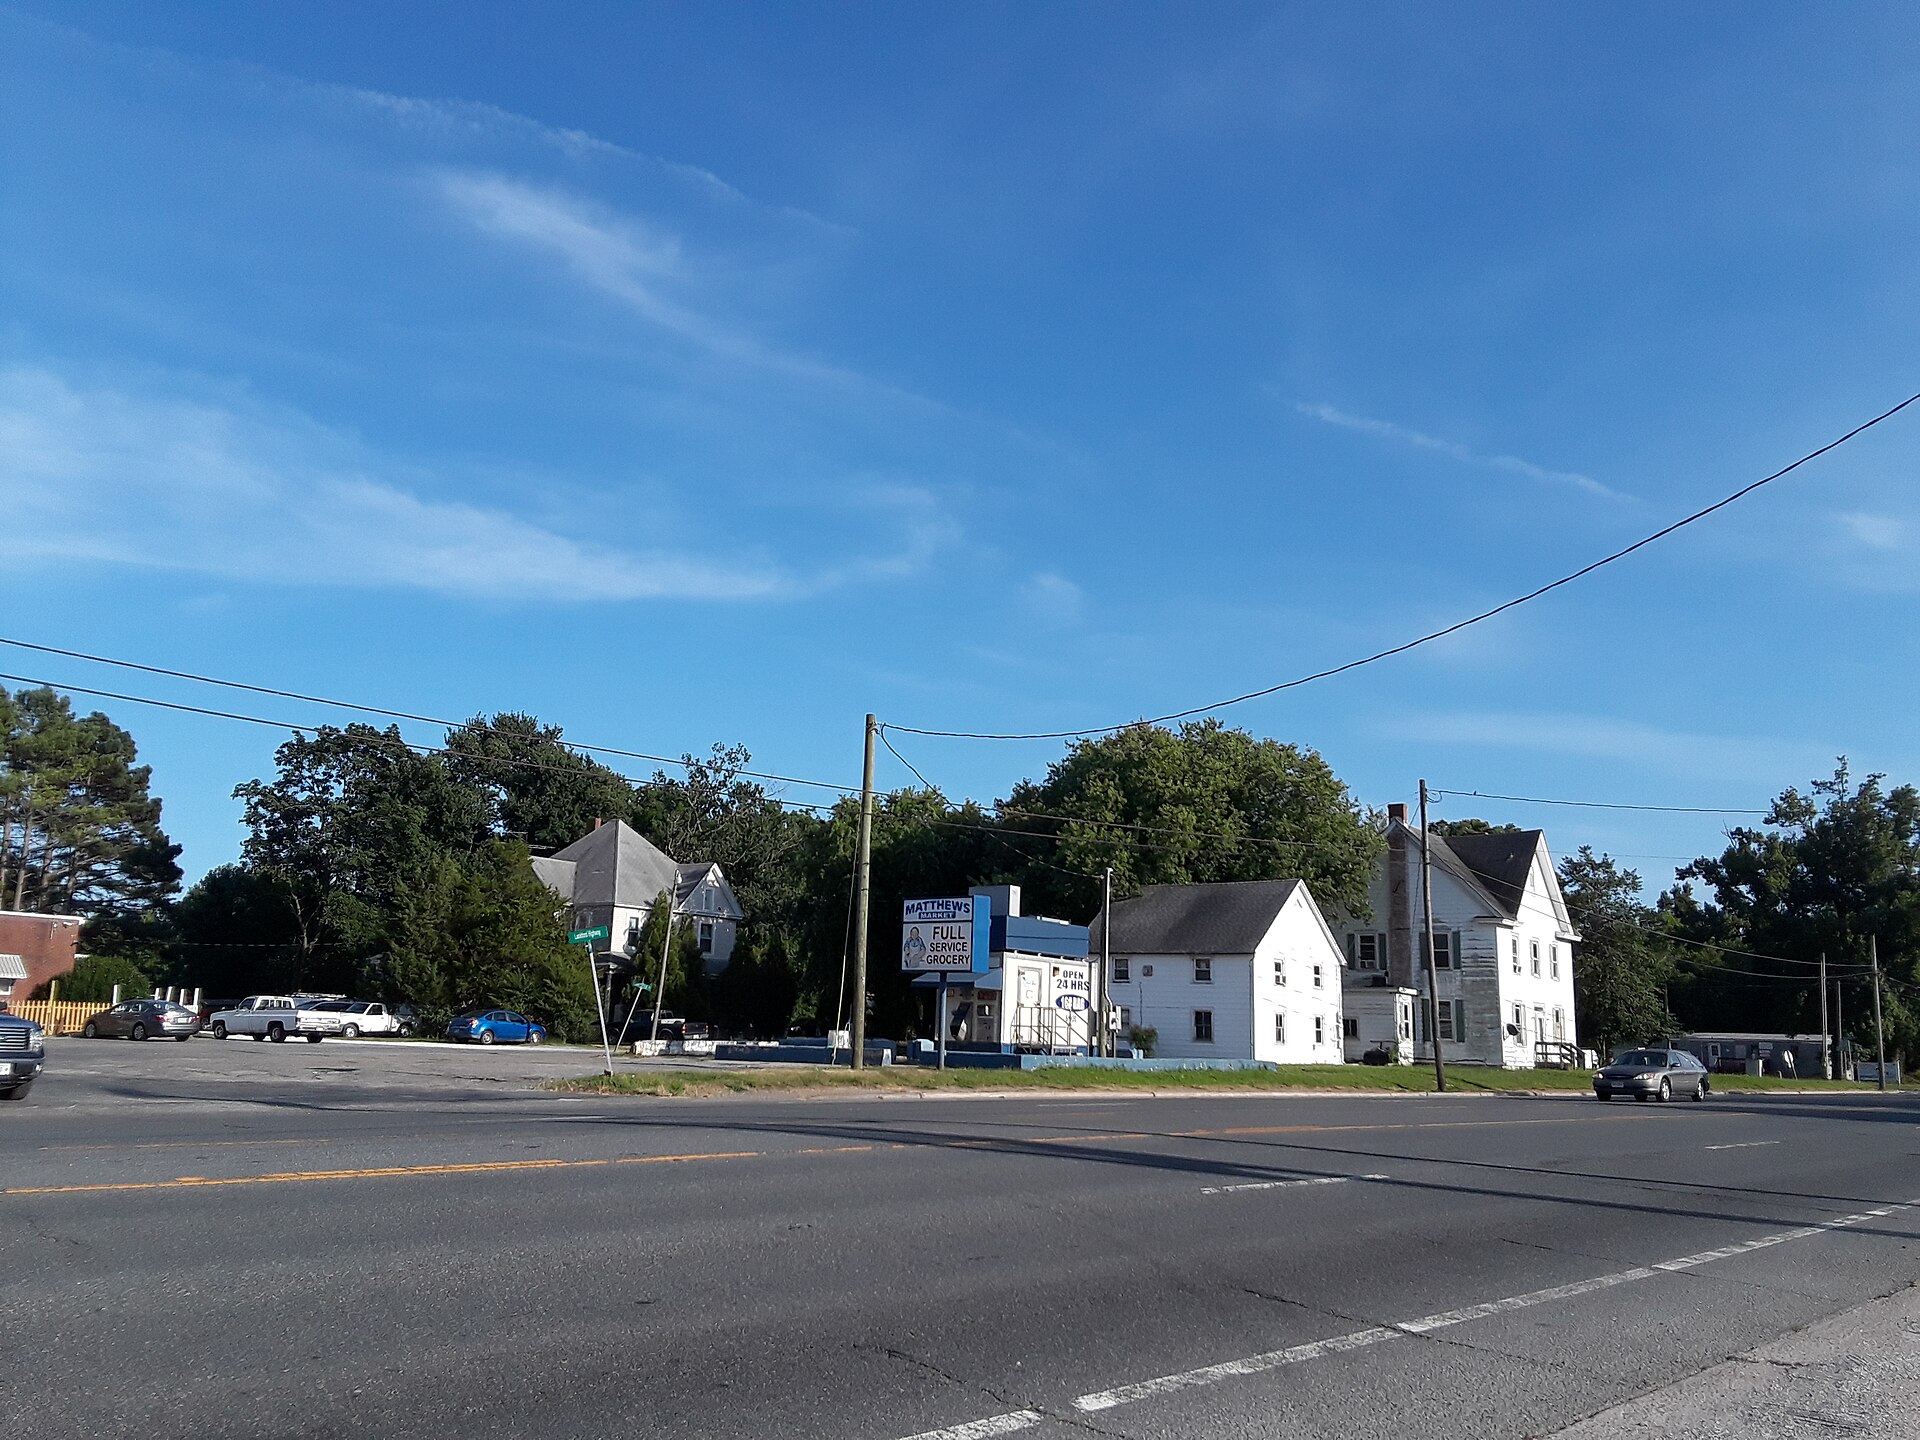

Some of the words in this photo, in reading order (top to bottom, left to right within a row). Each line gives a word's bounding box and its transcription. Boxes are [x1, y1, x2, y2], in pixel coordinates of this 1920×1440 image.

[905, 900, 970, 915] MATTHEWS
[932, 926, 965, 940] FULL
[929, 942, 968, 952] SERVICE
[926, 954, 970, 965] GROCERY
[1062, 970, 1084, 979] OPEN
[1056, 979, 1068, 989] 24
[1070, 980, 1090, 991] HRS
